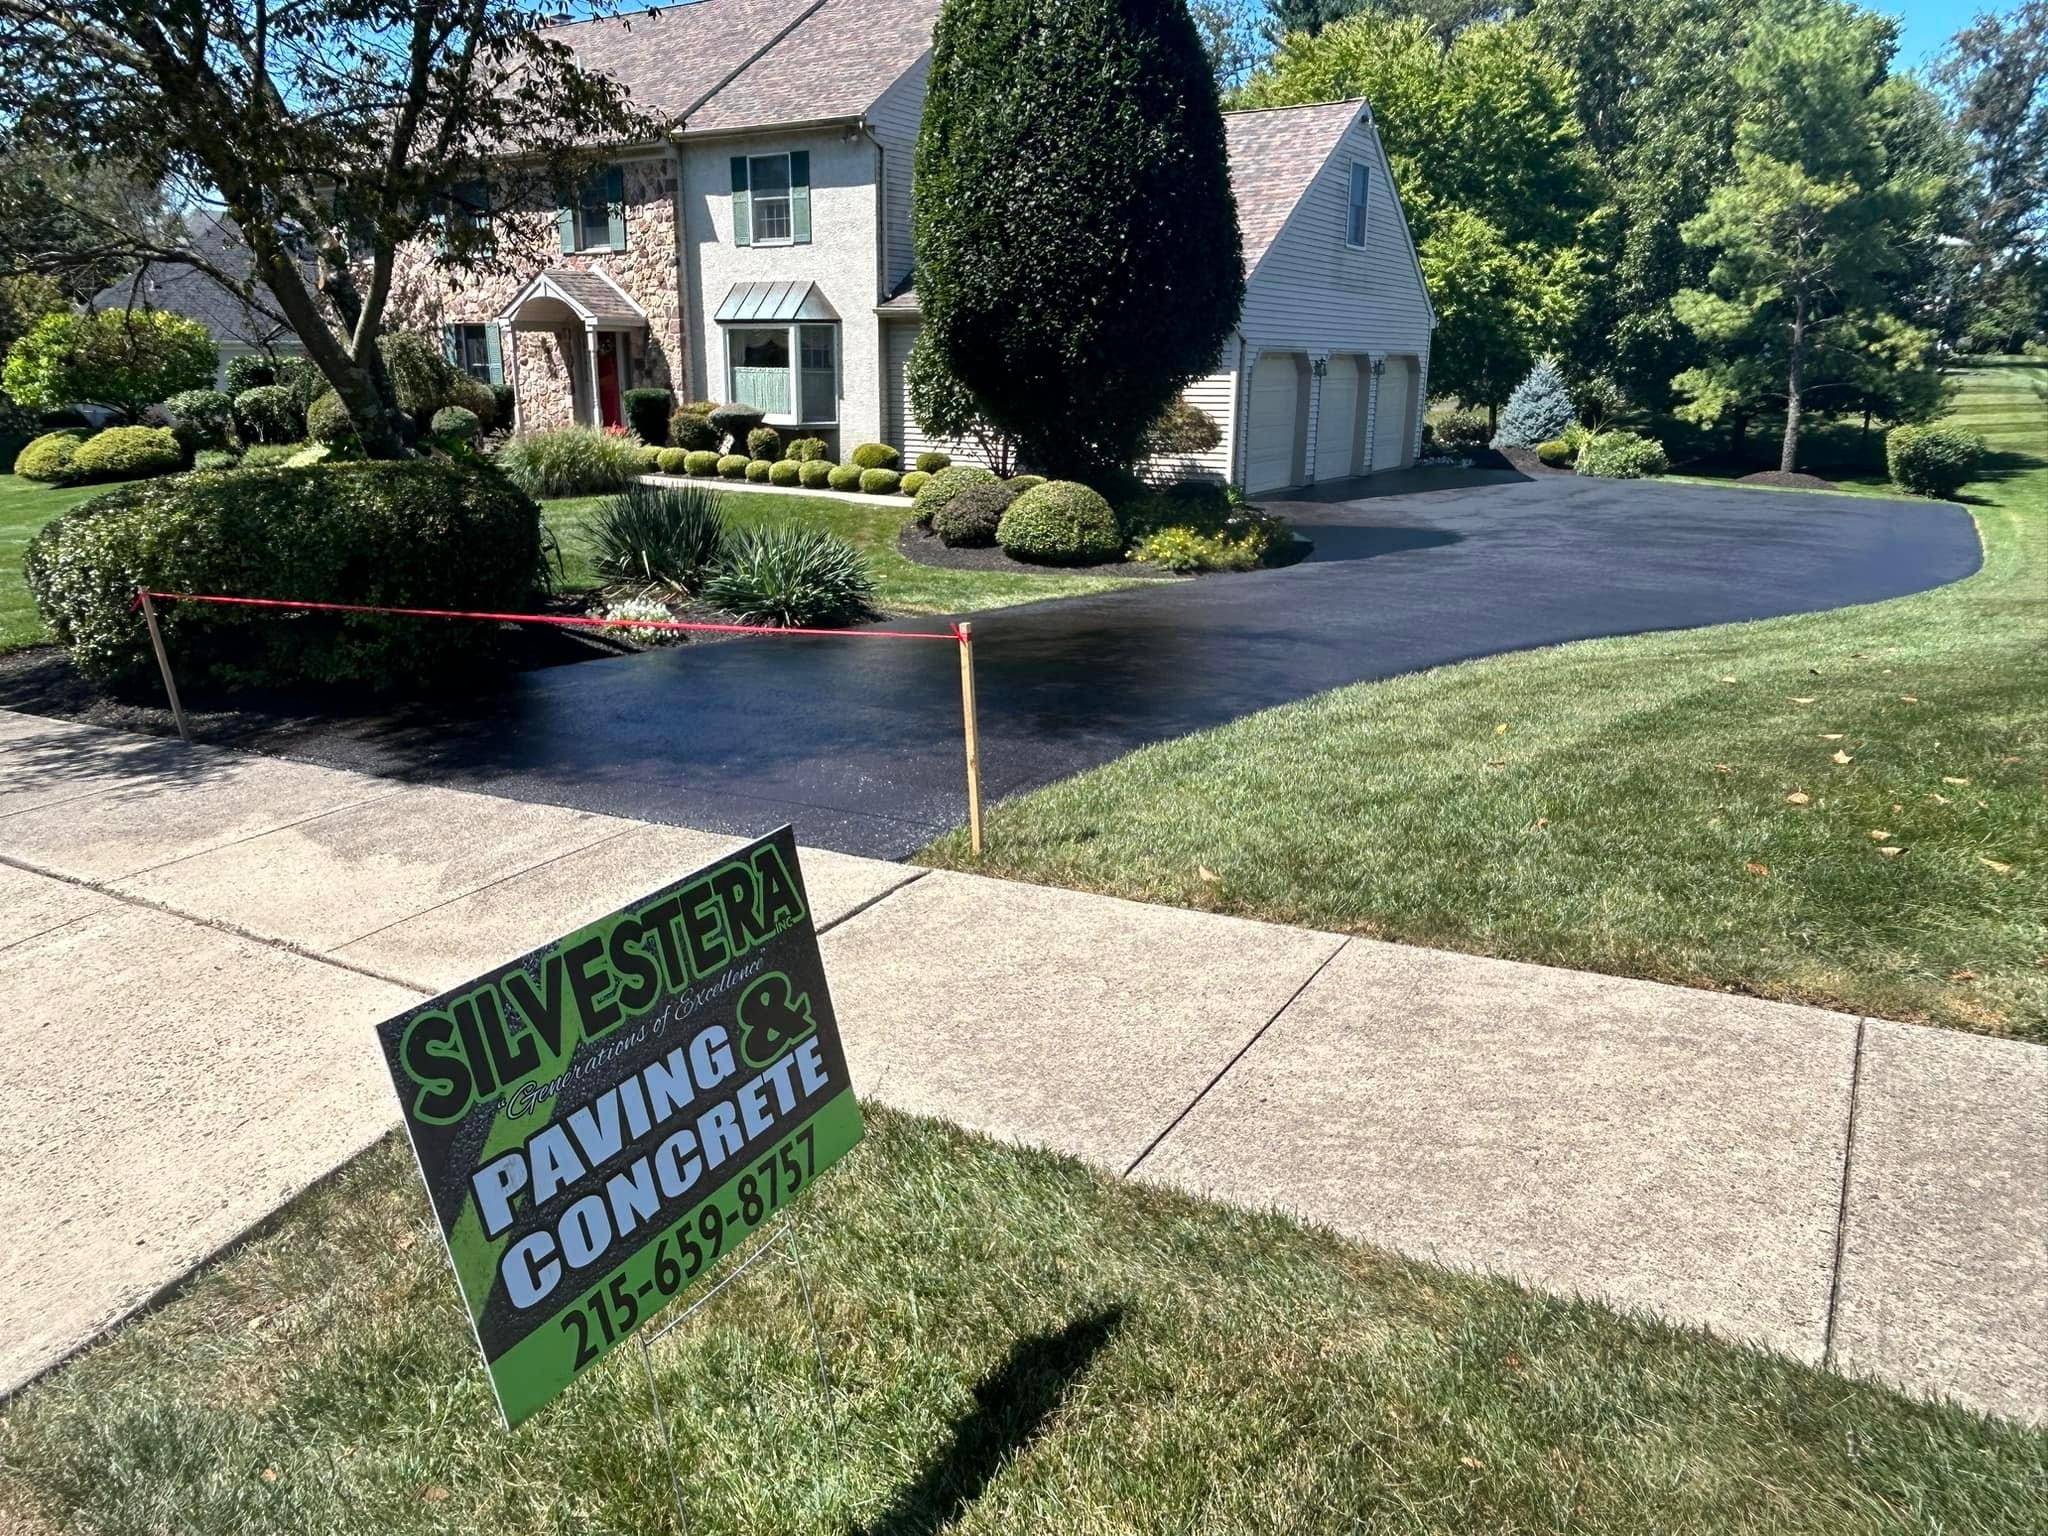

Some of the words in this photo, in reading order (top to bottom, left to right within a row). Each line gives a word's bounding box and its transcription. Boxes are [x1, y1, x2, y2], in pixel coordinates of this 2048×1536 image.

[402, 843, 806, 1125] SILVESTERA
[472, 1025, 736, 1236] PAVING
[736, 970, 817, 1070] &
[653, 1007, 672, 1038] of
[501, 1035, 829, 1309] CONCRETE
[561, 1123, 816, 1373] 215-659-8757
